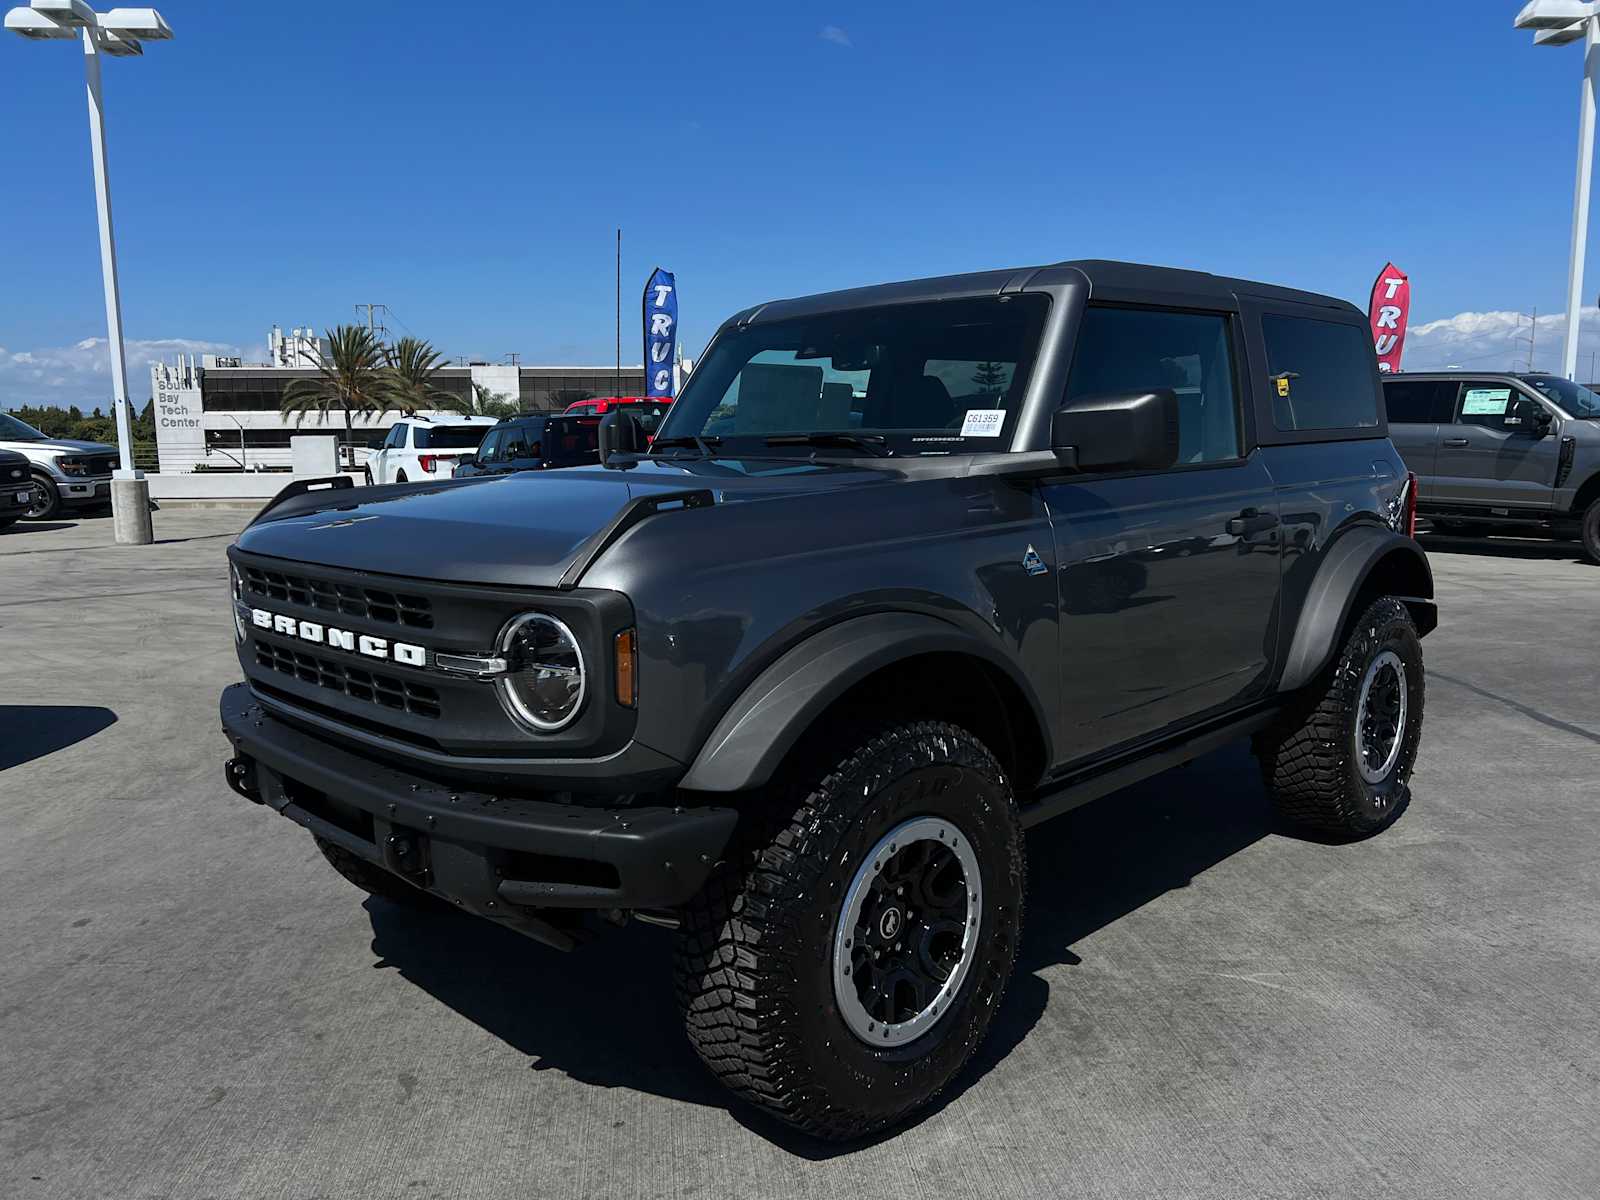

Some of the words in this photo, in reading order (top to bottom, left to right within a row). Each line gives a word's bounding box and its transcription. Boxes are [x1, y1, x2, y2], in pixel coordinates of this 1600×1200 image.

[651, 284, 673, 391] TRUC
[159, 393, 179, 404] Bay
[160, 405, 188, 415] Tech
[161, 418, 200, 427] Center
[967, 414, 999, 423] C61359
[252, 608, 426, 667] BRONCO
